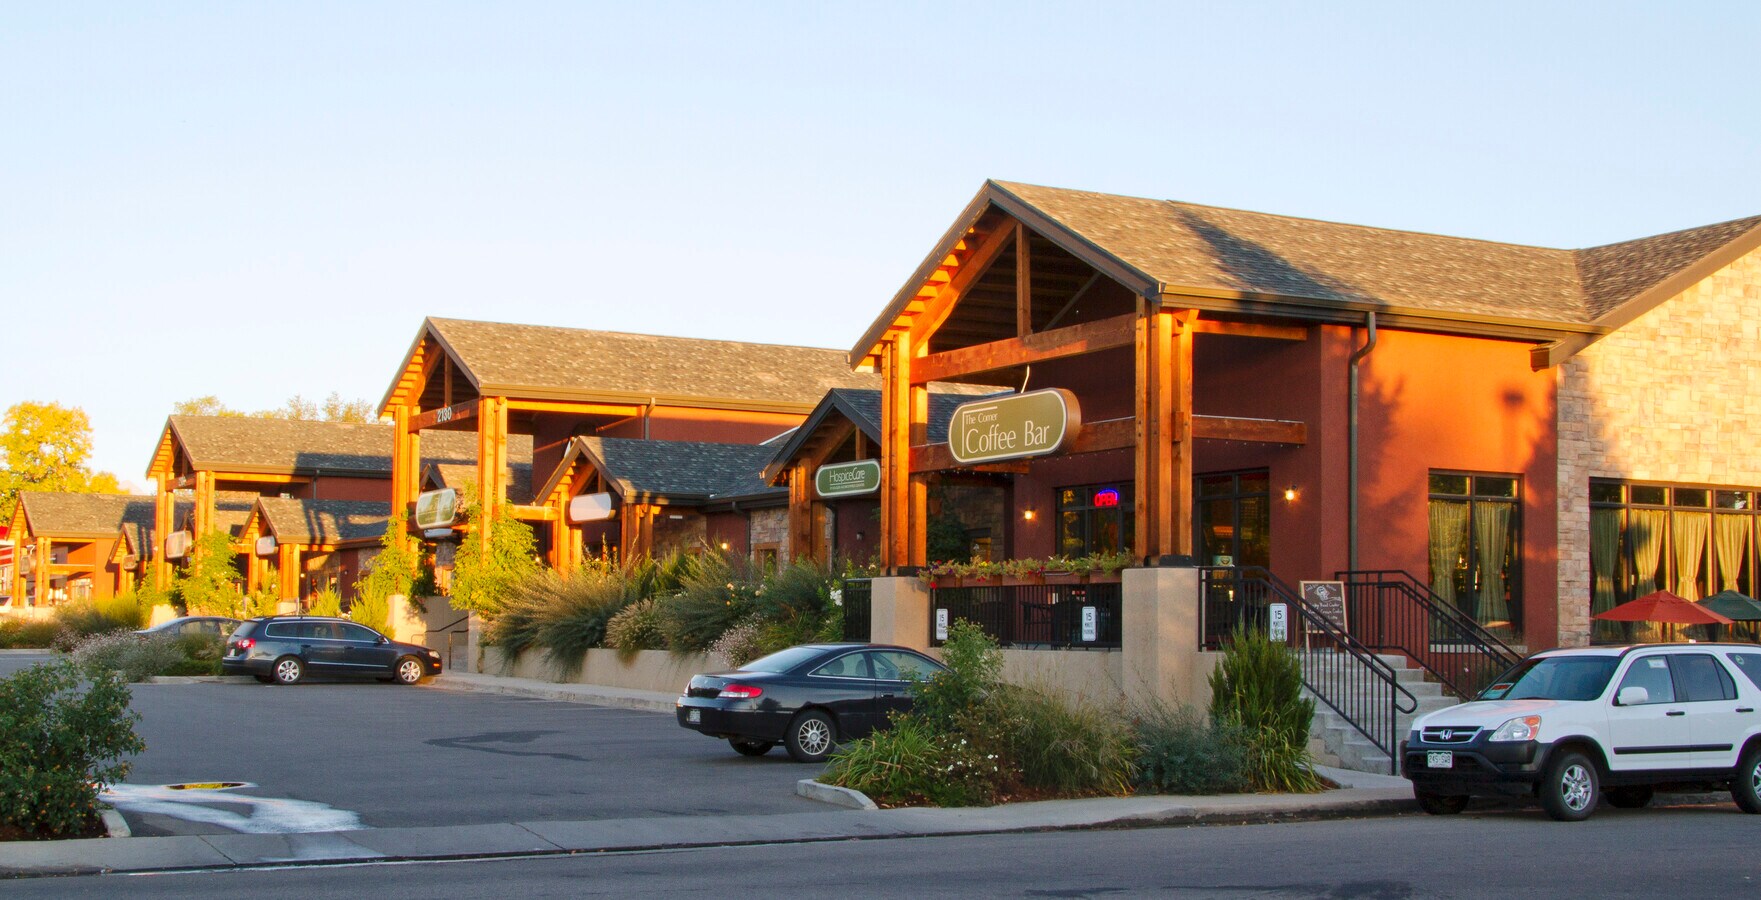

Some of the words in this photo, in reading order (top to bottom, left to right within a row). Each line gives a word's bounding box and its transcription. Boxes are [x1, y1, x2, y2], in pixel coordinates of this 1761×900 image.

[437, 406, 452, 422] 2130
[965, 415, 976, 425] The
[978, 412, 998, 423] Corner
[966, 423, 1017, 454] Coffee
[1024, 420, 1050, 447] Bar
[829, 467, 865, 484] HospiceCare
[1094, 492, 1117, 507] OPEN
[1086, 612, 1092, 621] 15
[1274, 610, 1283, 620] 15
